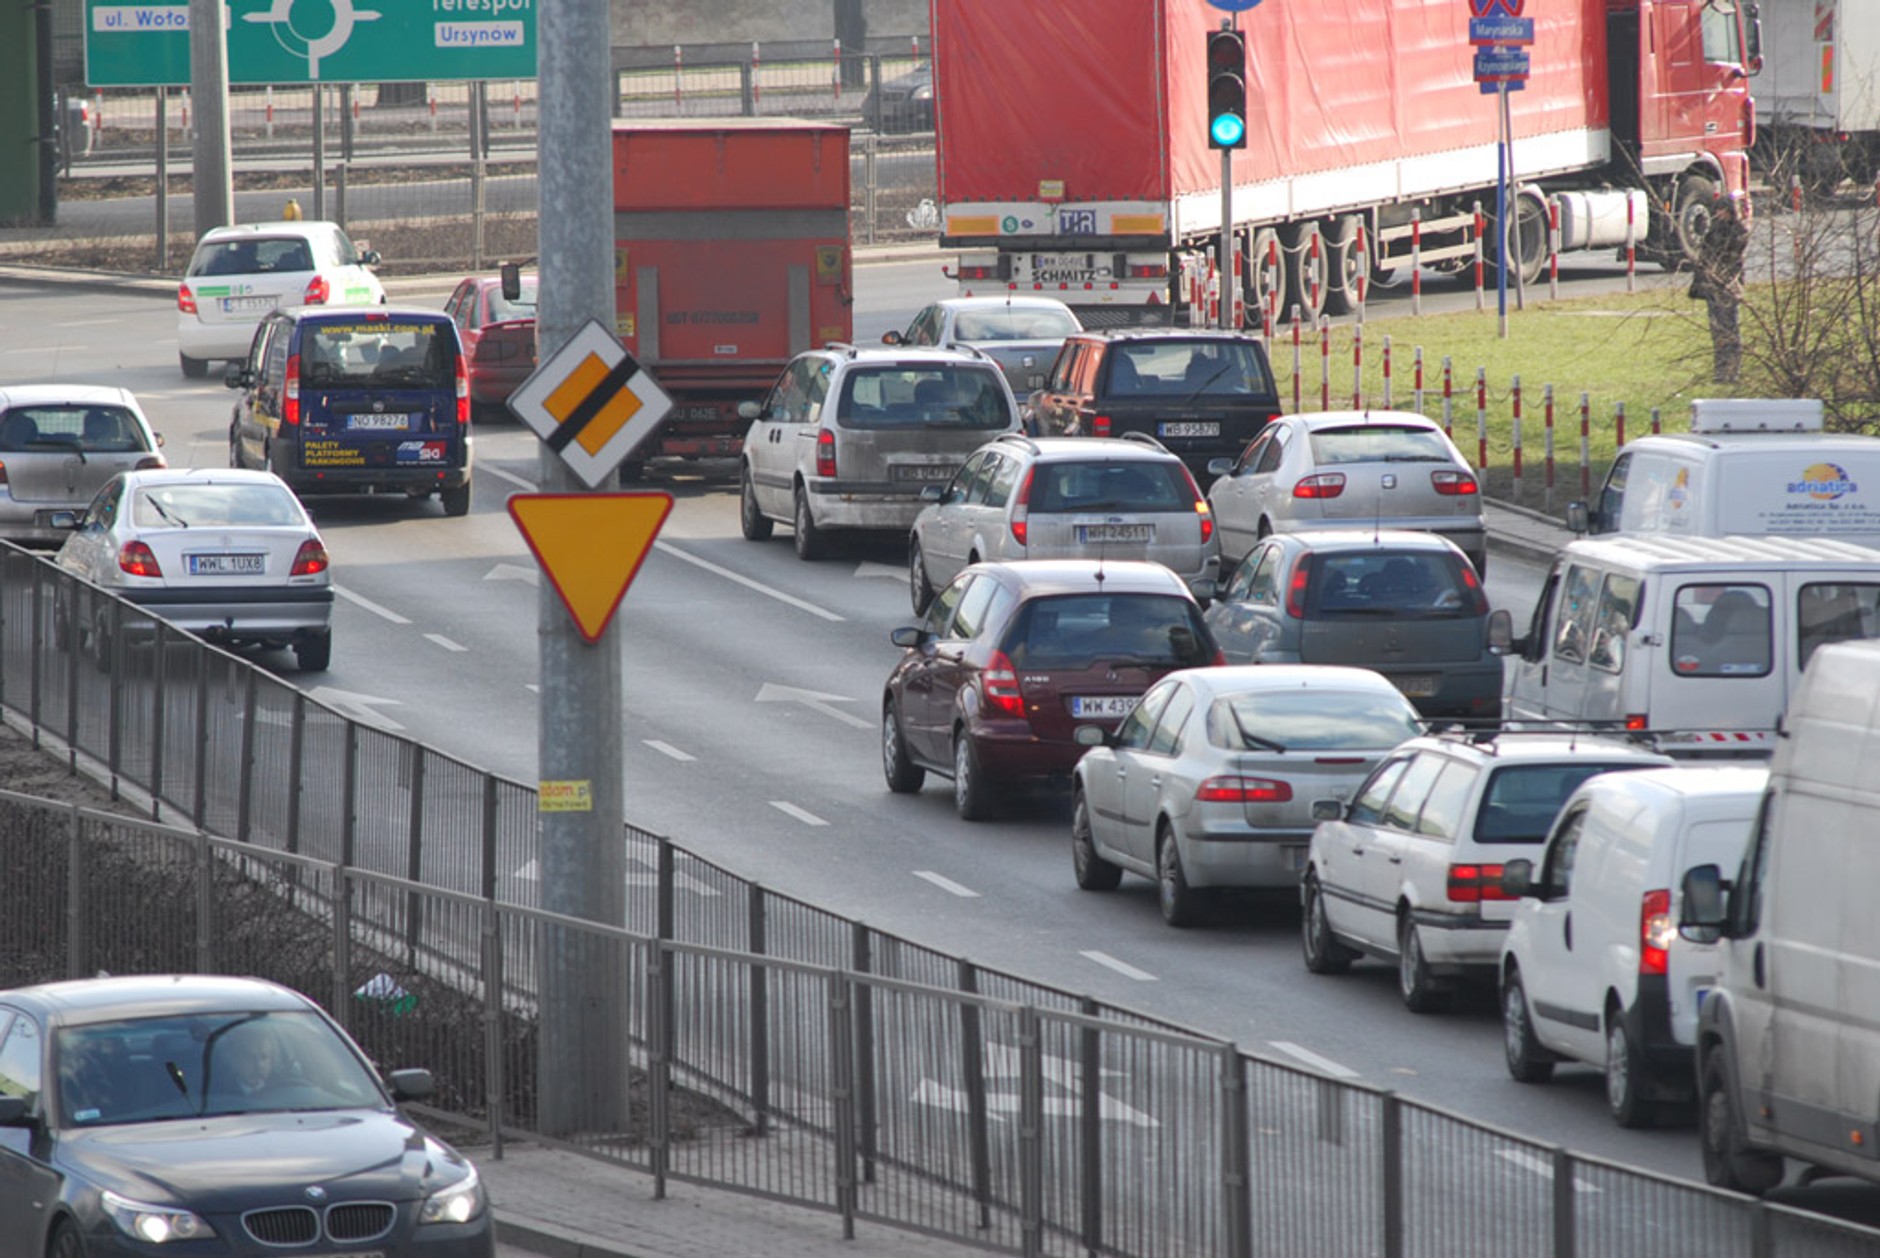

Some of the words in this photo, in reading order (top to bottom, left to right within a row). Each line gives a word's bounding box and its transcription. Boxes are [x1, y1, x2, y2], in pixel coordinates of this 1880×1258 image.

[105, 11, 128, 27] ul.
[135, 11, 190, 27] Woło
[440, 25, 517, 45] Ursynów
[1061, 212, 1093, 232] TIR
[1031, 269, 1096, 281] SCHMITZ
[305, 441, 339, 449] PALETY
[1787, 481, 1857, 493] adriatica
[199, 558, 226, 571] WWL
[1083, 700, 1104, 713] WW
[1108, 700, 1140, 713] 439
